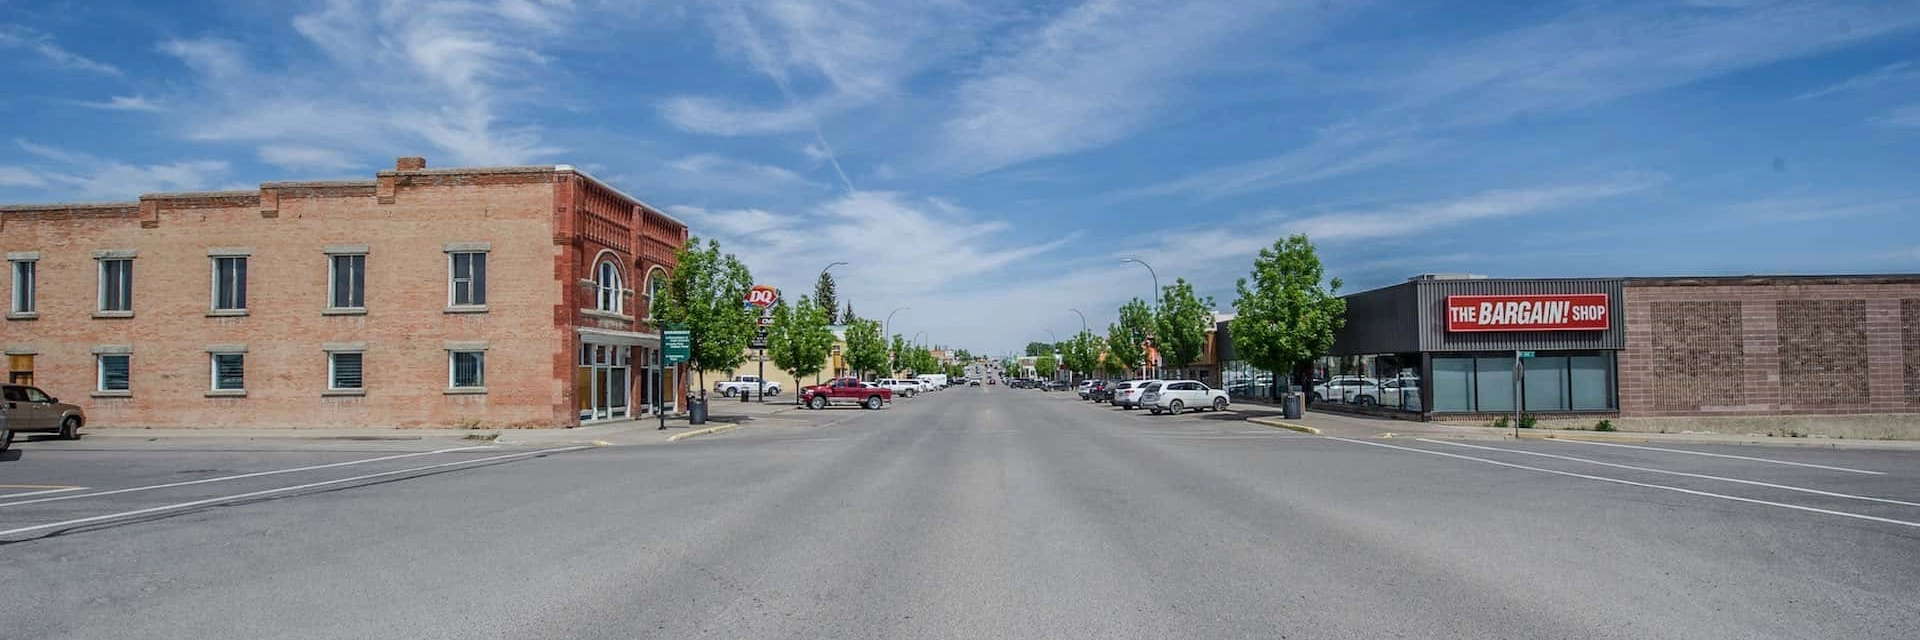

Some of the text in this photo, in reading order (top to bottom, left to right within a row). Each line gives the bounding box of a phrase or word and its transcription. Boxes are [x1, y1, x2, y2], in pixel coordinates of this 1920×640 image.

[749, 290, 772, 303] DQ
[1450, 301, 1605, 325] THE BARGAIN! SHOP
